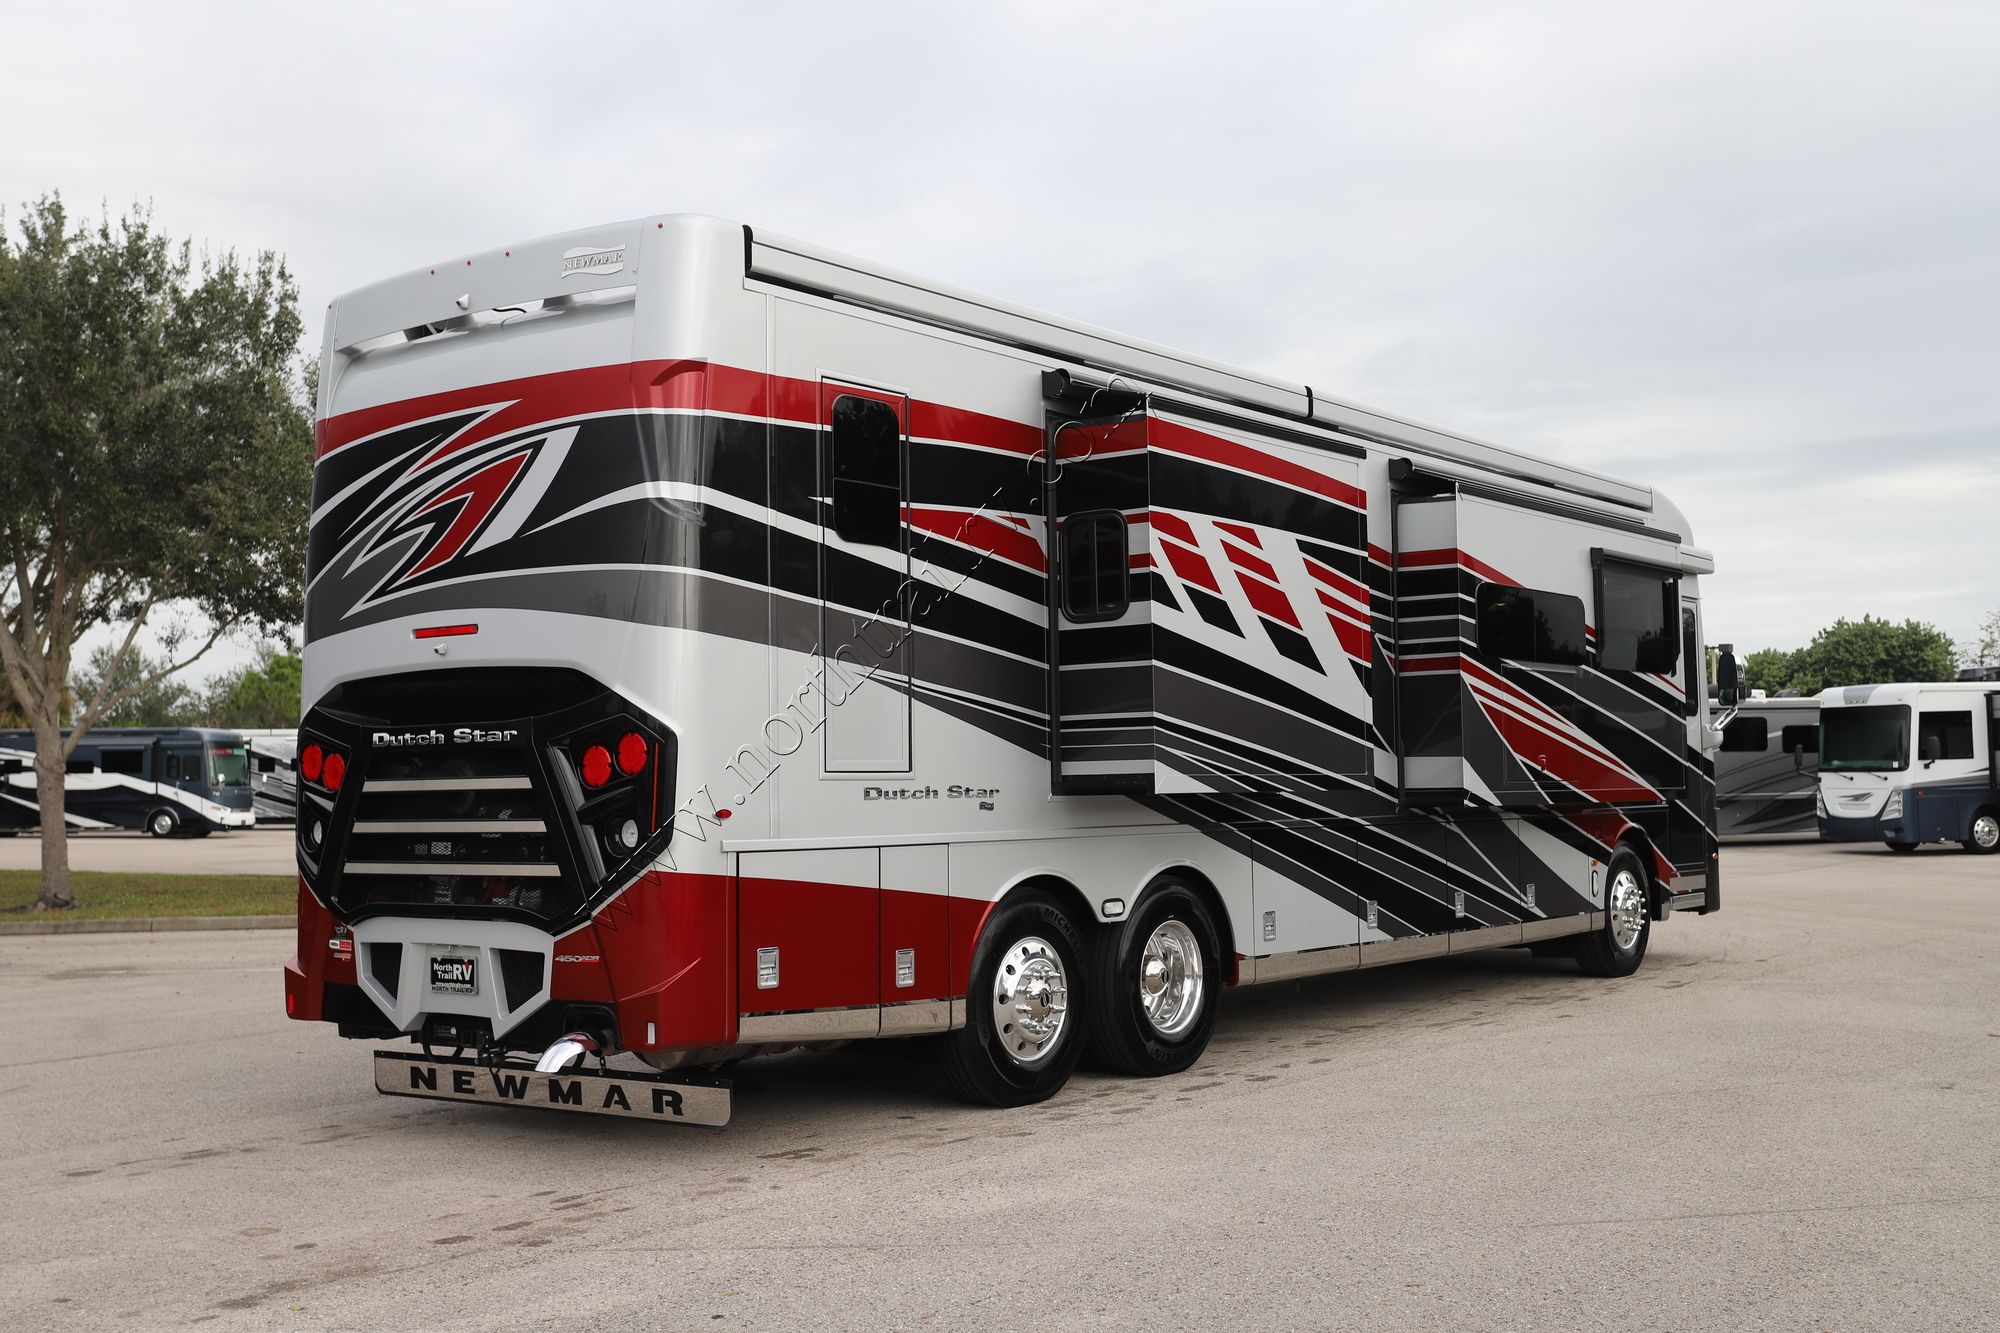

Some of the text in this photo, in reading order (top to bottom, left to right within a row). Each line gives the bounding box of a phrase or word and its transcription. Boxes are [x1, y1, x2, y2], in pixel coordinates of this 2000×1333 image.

[562, 252, 624, 272] NEWMAR
[372, 728, 518, 748] Dutch Star
[863, 785, 1000, 801] Dutch Star
[433, 962, 453, 972] North
[437, 971, 453, 980] Trail
[453, 963, 473, 981] RV
[410, 1066, 684, 1117] NEWMAR
